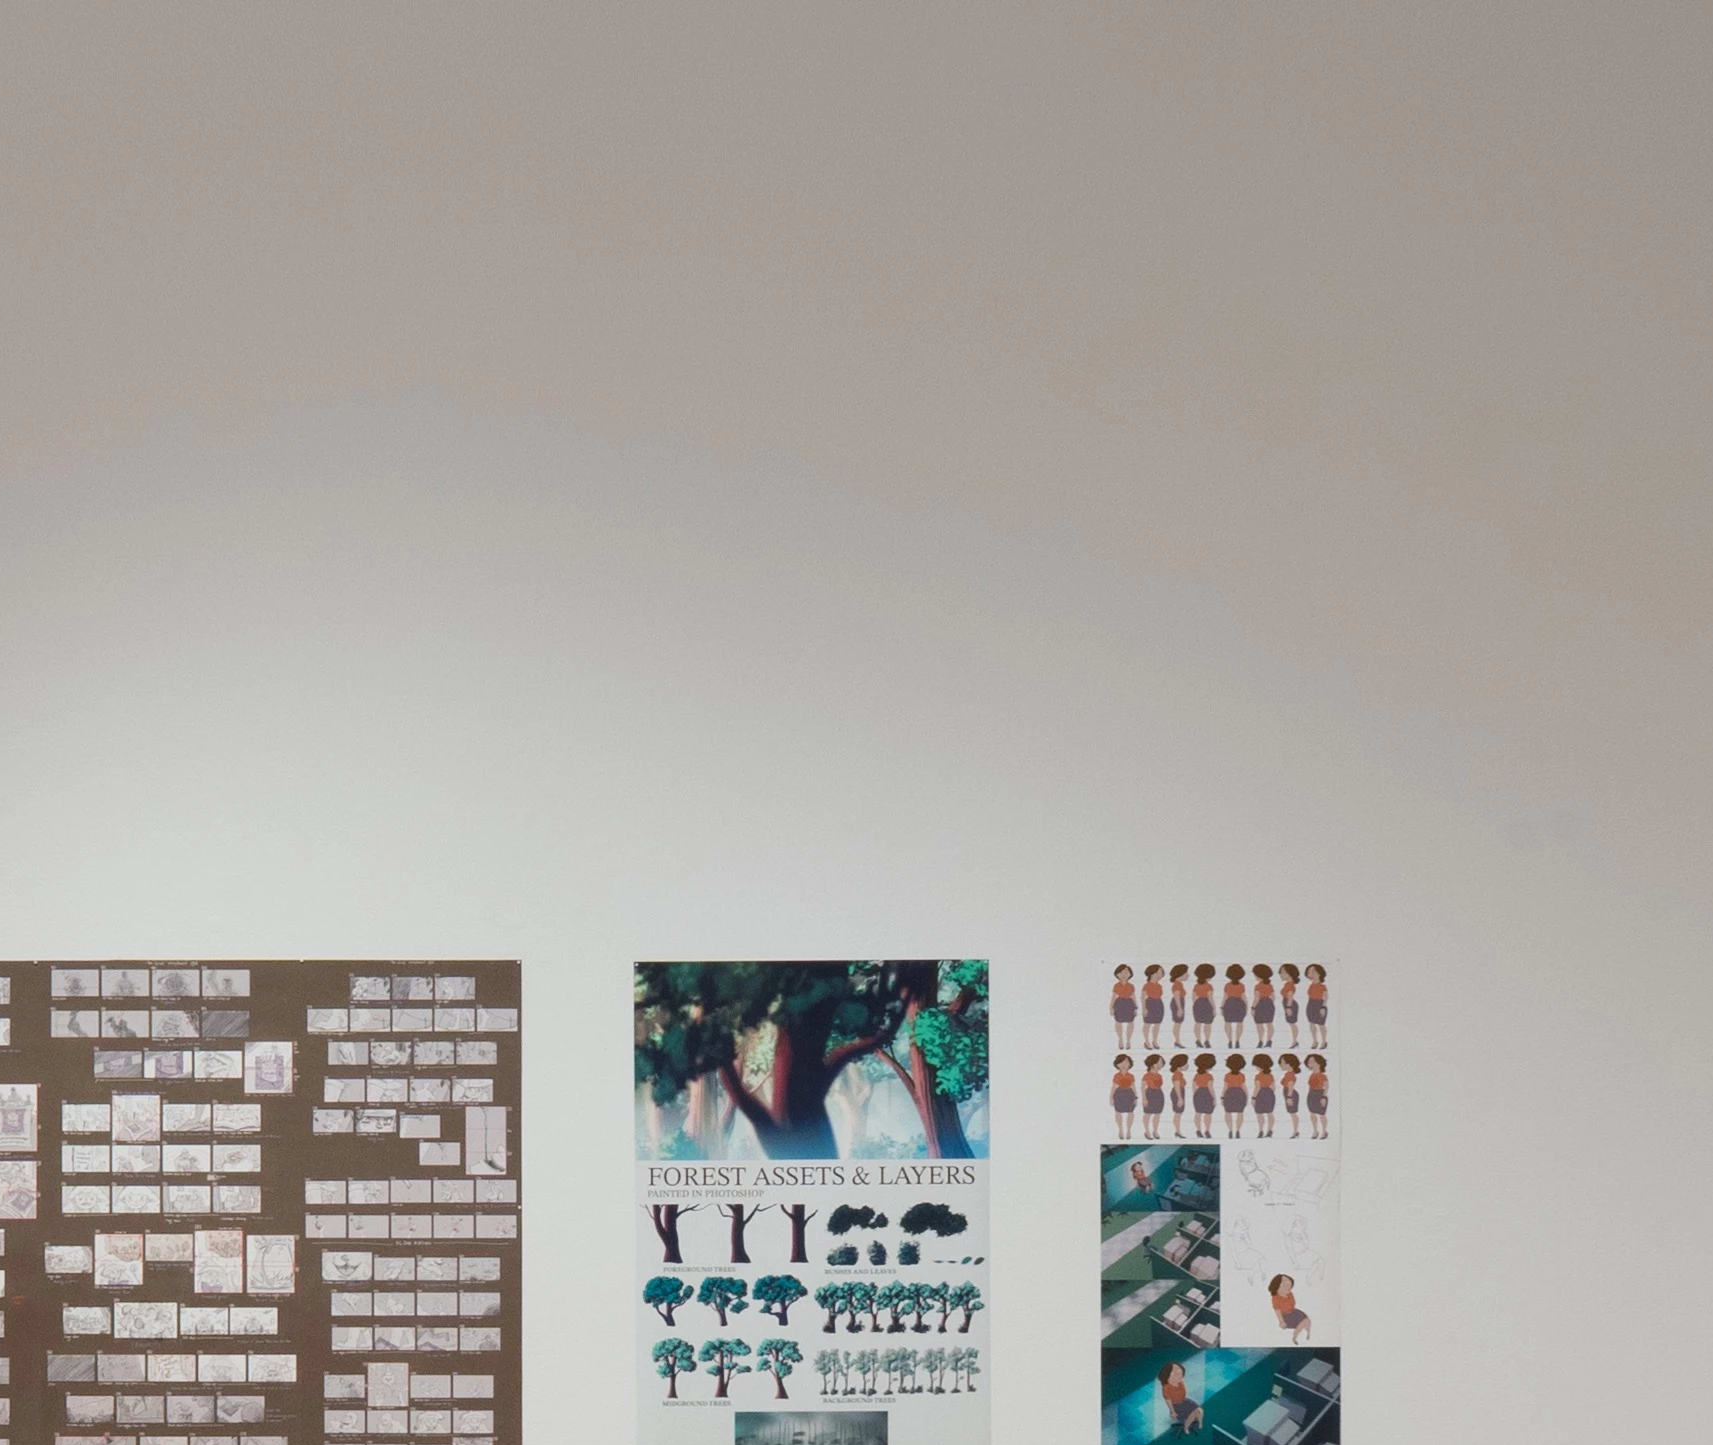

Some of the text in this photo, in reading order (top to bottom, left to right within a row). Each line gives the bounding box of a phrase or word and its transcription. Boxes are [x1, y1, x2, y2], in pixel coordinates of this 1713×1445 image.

[648, 1165, 975, 1187] FOREST ASSETS & LAYERS
[647, 1189, 765, 1198] PAINTED IN PHOTOSHOP
